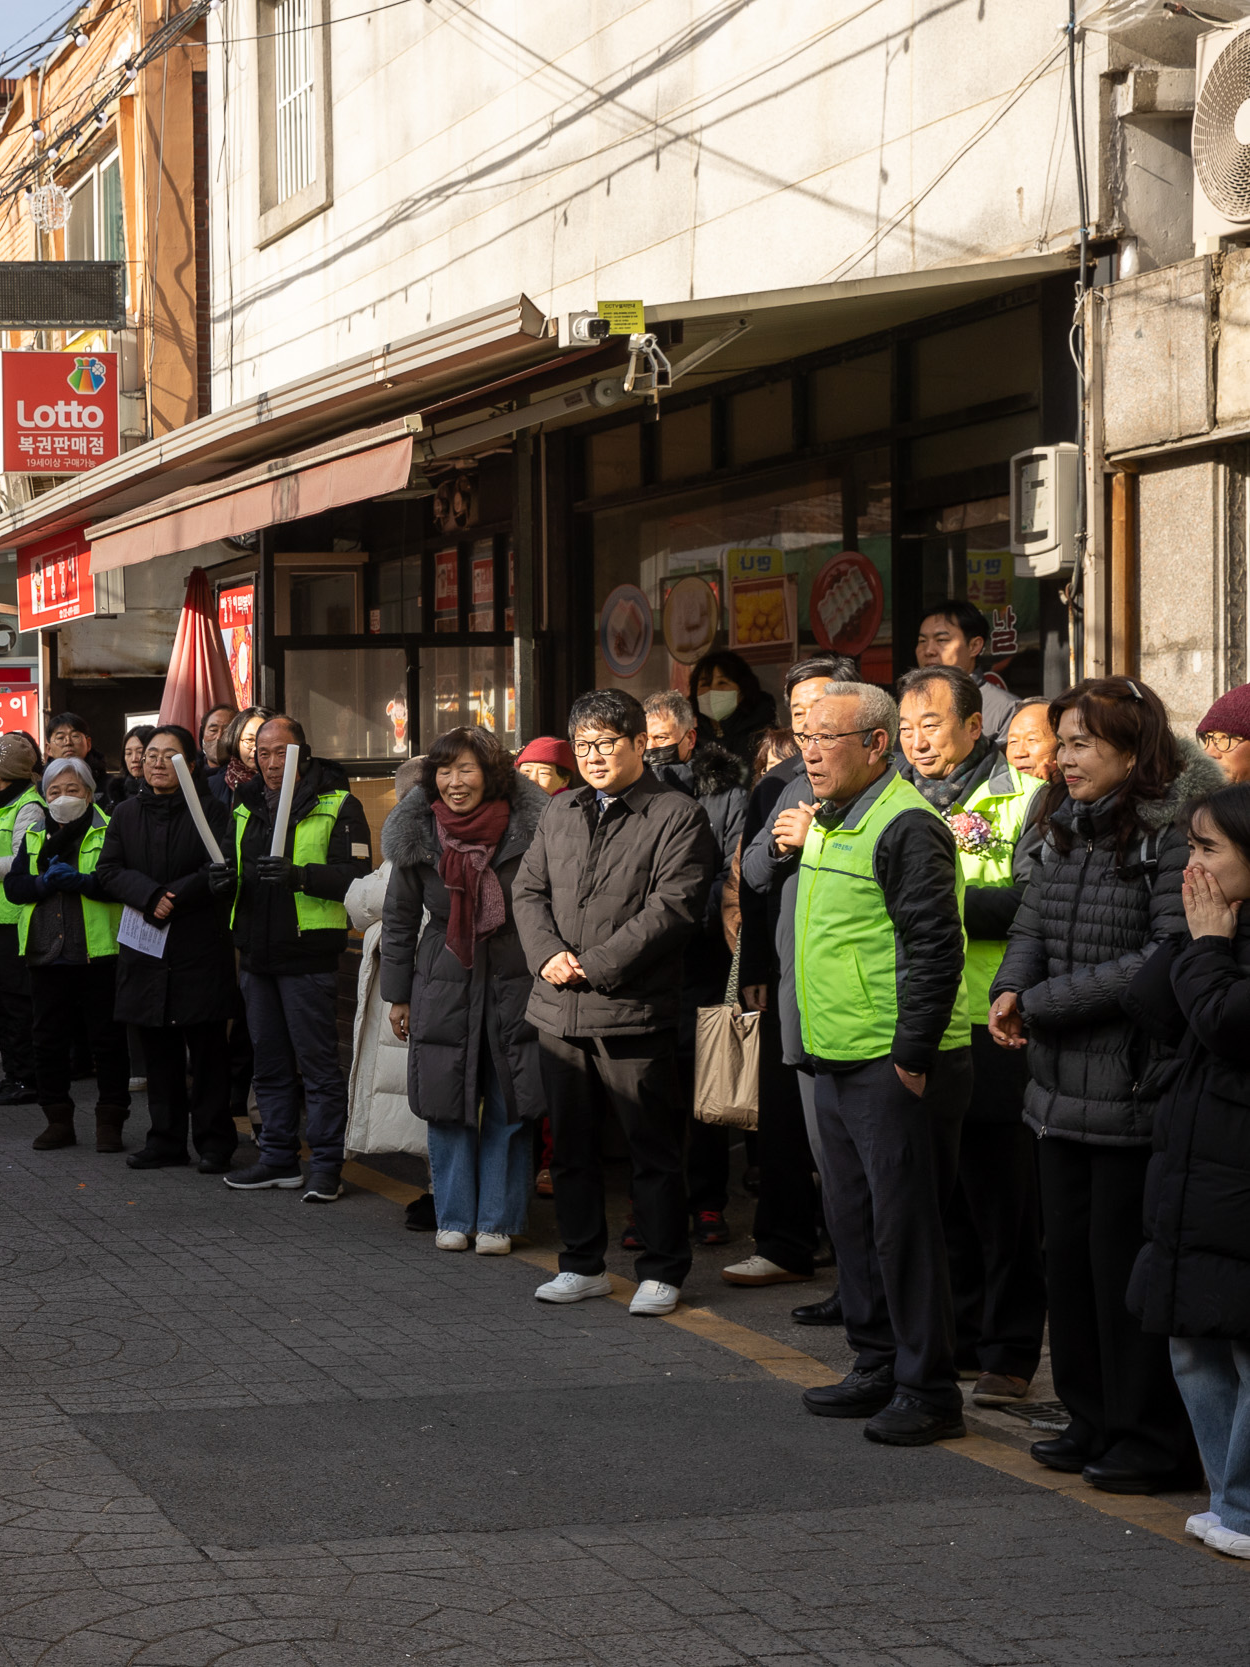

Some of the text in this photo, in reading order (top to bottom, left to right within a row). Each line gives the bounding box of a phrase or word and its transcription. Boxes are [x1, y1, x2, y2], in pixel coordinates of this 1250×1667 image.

[17, 400, 105, 428] Lotto
[18, 436, 104, 455] 복권판매점
[26, 458, 96, 468] 19세이상 구매가능
